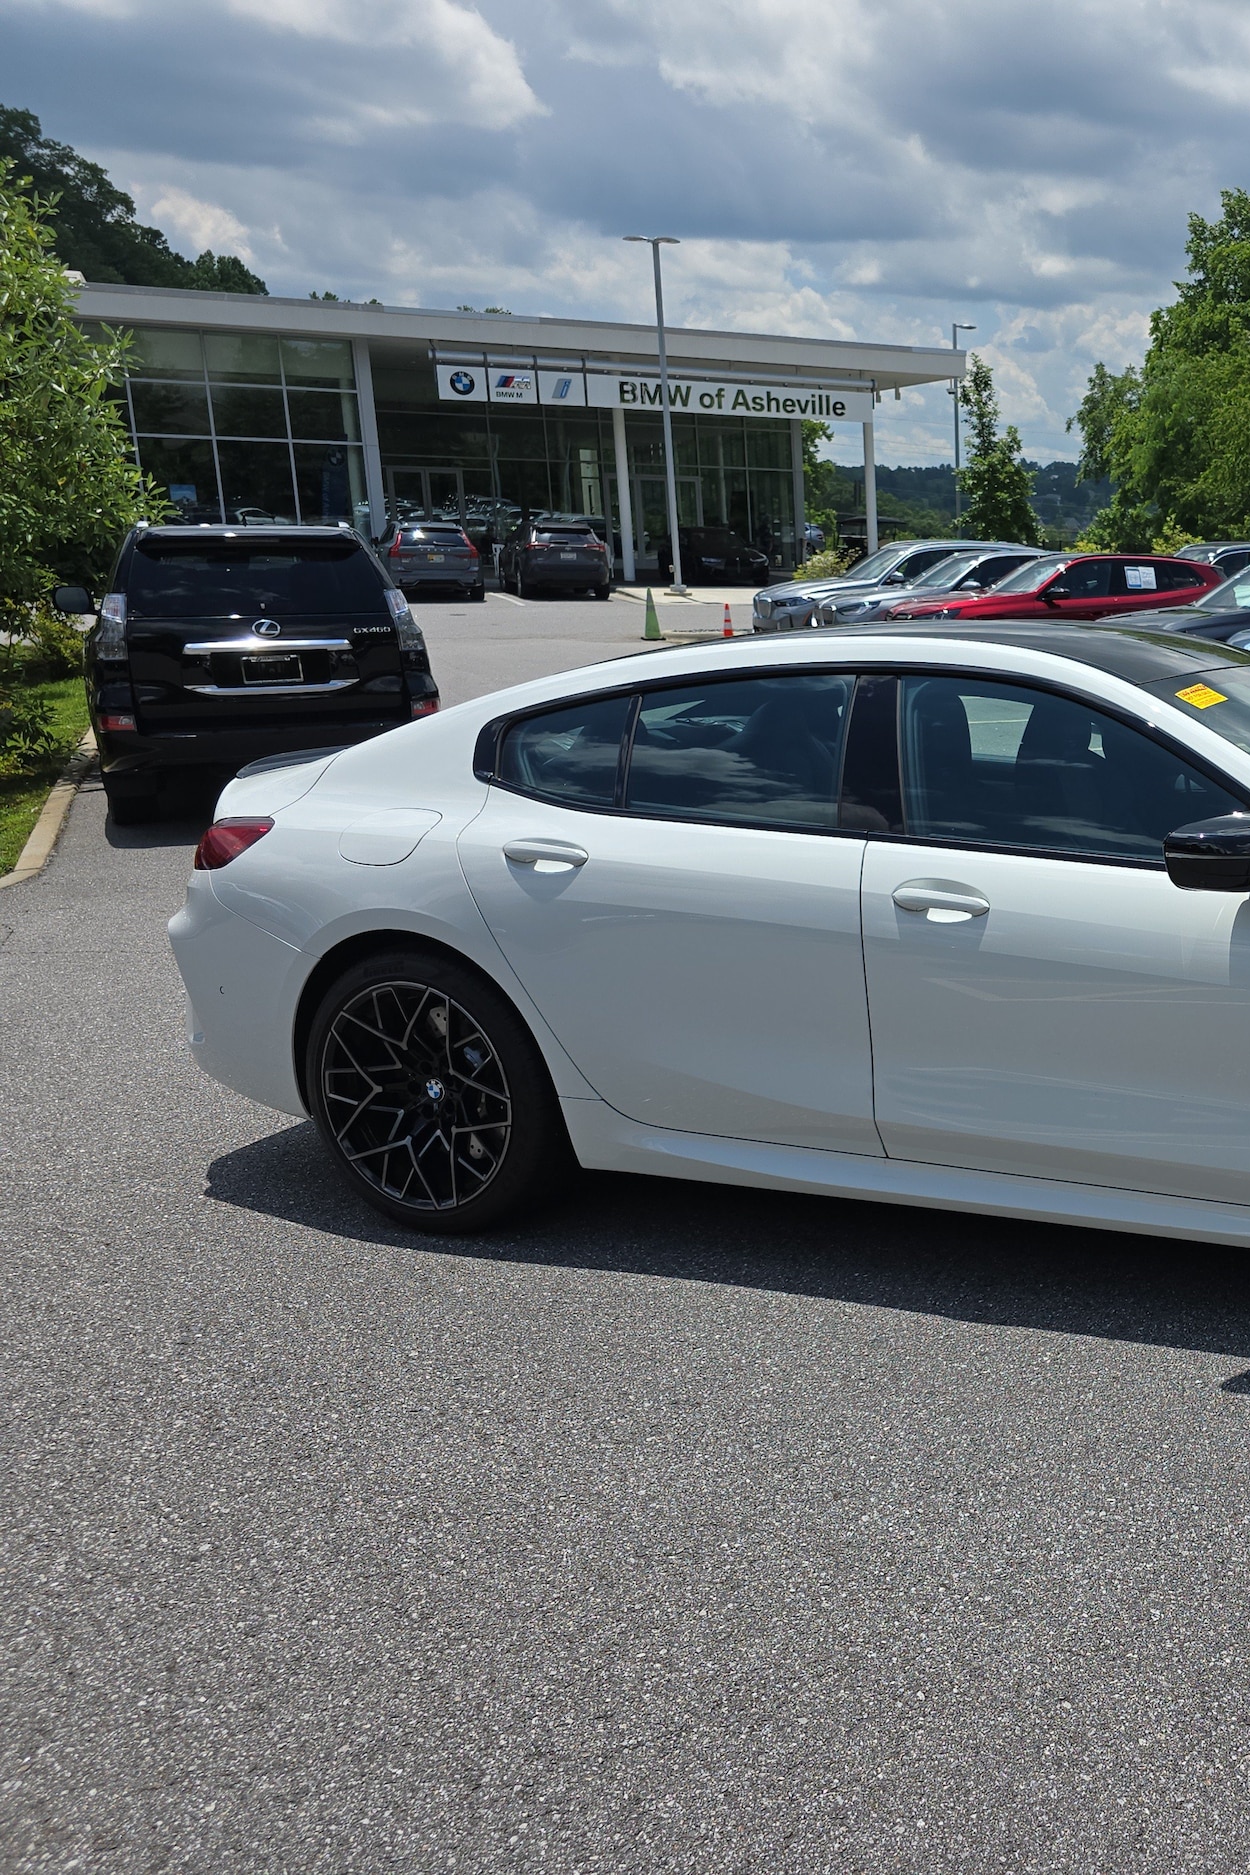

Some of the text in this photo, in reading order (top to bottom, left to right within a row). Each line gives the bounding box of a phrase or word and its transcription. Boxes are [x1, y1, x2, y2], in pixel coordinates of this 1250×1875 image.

[619, 381, 846, 417] BMW of Asheville
[353, 626, 391, 634] GX460
